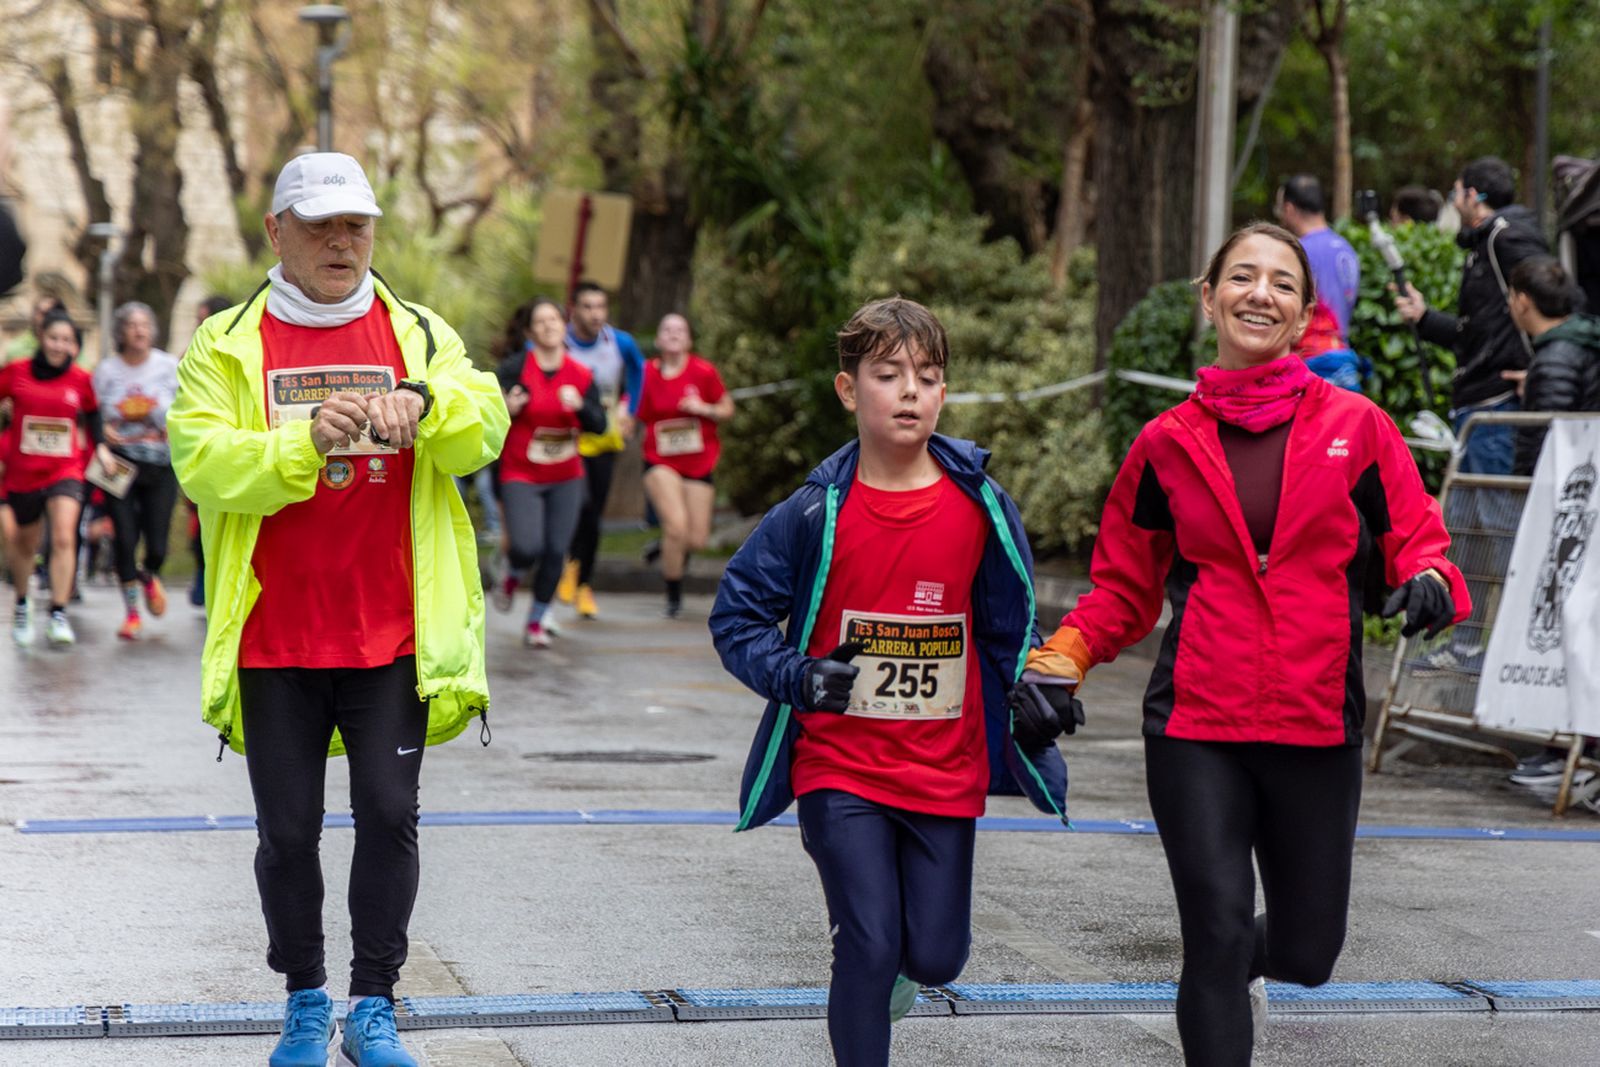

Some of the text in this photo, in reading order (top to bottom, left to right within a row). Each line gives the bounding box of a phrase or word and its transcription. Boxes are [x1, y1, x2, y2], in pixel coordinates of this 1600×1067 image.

[323, 173, 346, 187] edp
[280, 372, 384, 388] IES San Juan Bosco
[279, 389, 287, 402] V
[855, 622, 960, 639] IES San Juan Bosco
[862, 637, 961, 657] CARRERA POPULAR
[875, 661, 939, 699] 255
